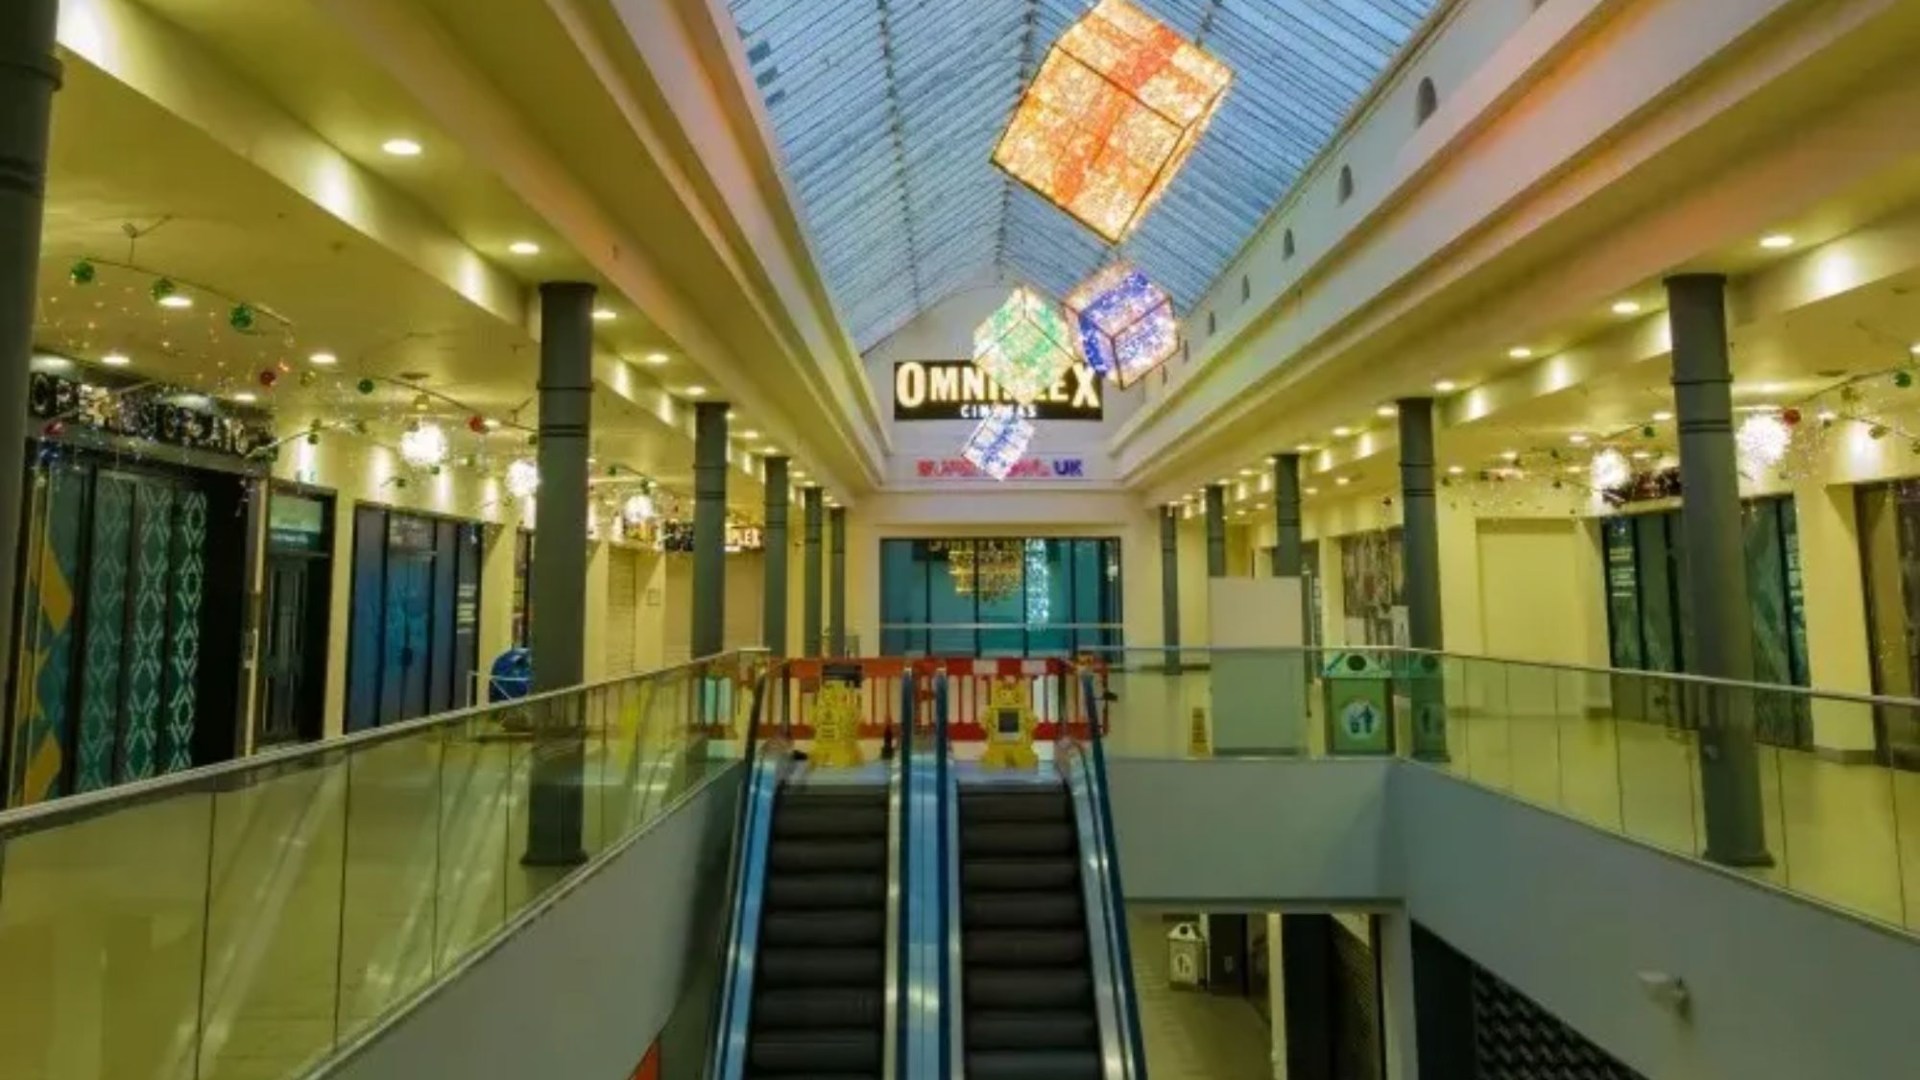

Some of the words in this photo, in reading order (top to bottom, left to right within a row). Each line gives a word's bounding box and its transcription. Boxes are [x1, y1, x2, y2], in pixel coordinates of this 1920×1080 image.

[896, 361, 1100, 408] OMNIEX
[960, 403, 1037, 418] CINAS
[1053, 459, 1083, 476] UK
